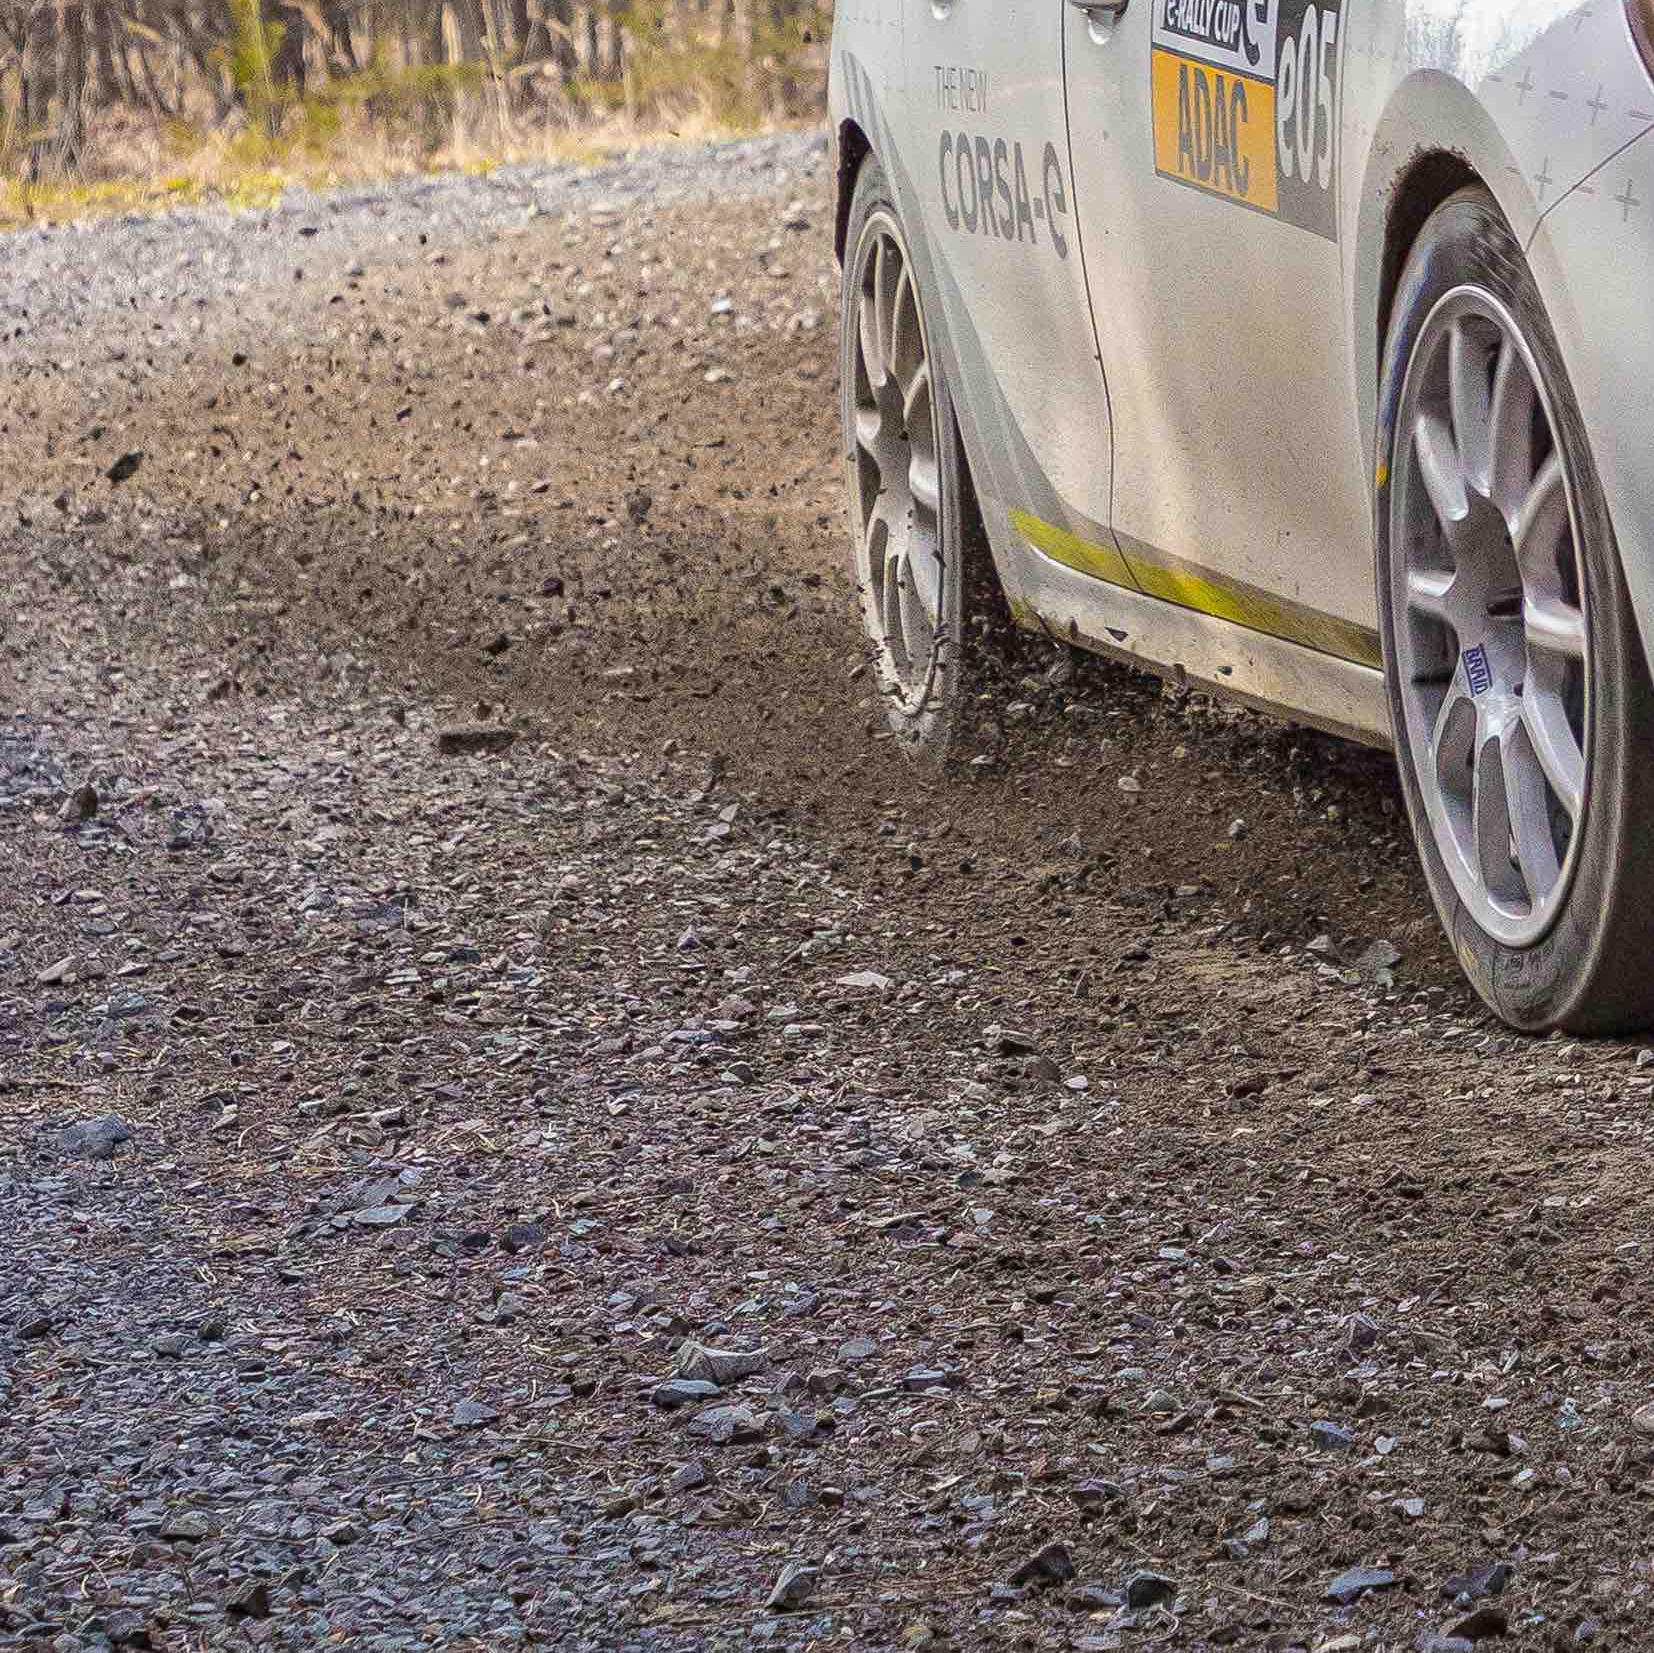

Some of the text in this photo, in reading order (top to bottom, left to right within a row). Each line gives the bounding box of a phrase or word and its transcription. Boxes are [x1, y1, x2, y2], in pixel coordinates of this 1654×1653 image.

[1213, 0, 1241, 45] CUP
[934, 65, 958, 112] THE
[1277, 3, 1337, 190] e05
[1177, 63, 1249, 198] ADAC
[1465, 648, 1489, 695] BRAID
